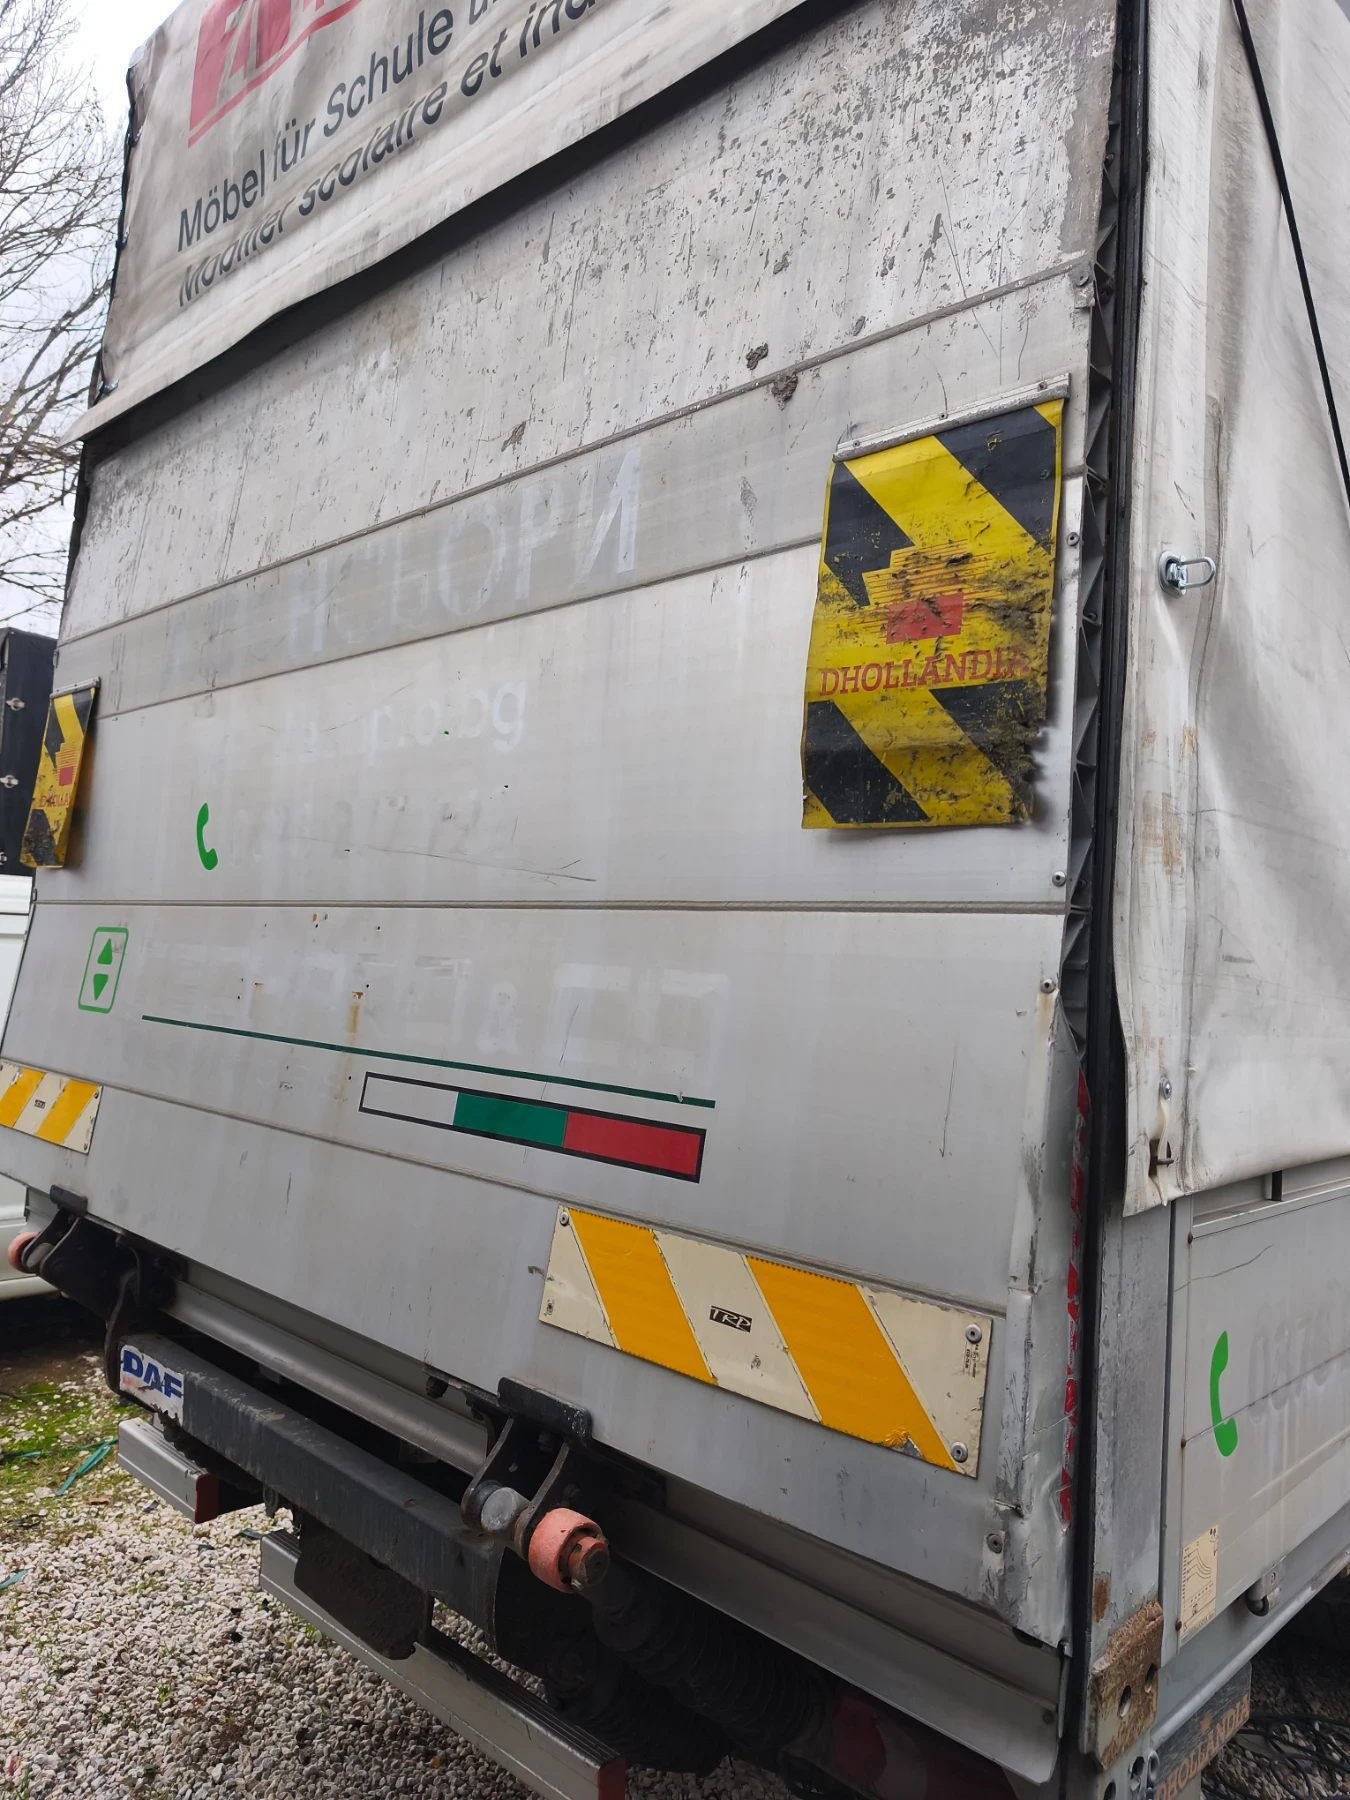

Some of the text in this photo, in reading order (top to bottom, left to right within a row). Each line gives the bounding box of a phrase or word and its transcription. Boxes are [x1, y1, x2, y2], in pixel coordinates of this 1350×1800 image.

[178, 149, 265, 252] Möbel
[273, 117, 316, 182] für
[324, 9, 453, 137] Schule
[299, 82, 448, 216] scolaire
[461, 28, 508, 97] et
[820, 644, 1030, 697] DHOLLANDIA
[710, 1307, 751, 1332] TRP
[123, 1350, 182, 1398] DAF
